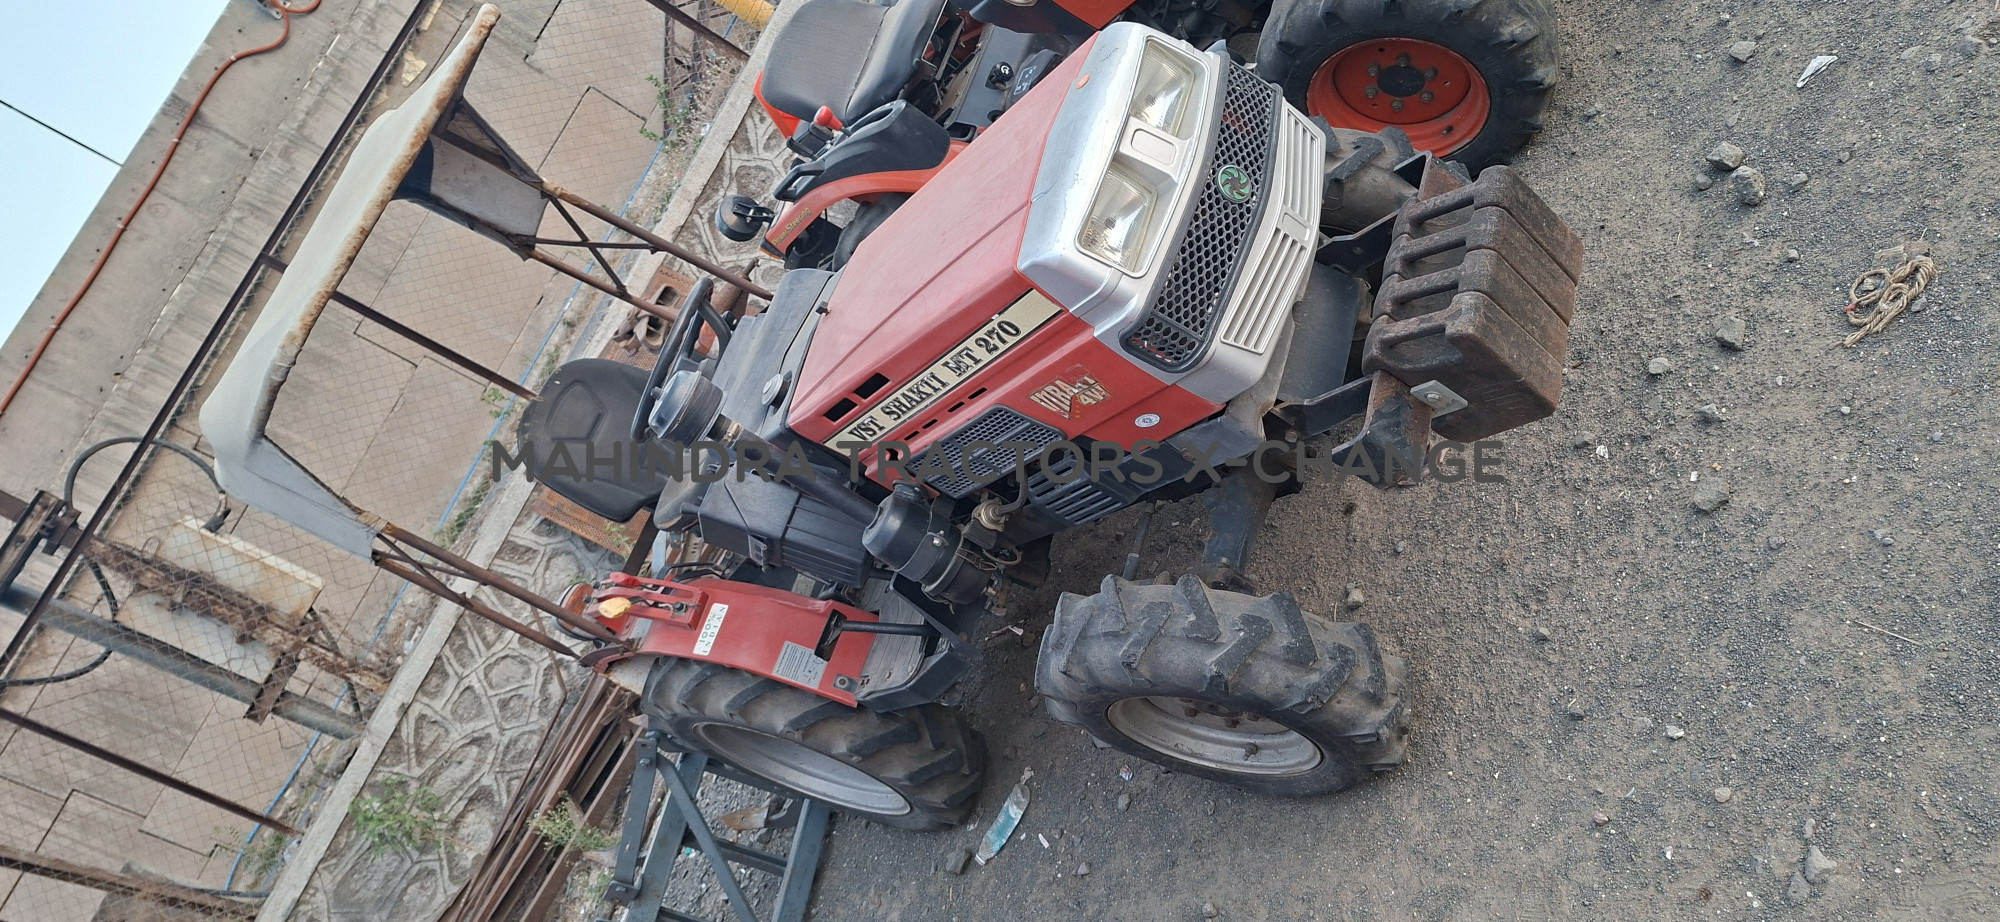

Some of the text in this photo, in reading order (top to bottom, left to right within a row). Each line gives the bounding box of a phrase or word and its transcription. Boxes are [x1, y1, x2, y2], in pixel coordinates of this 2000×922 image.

[847, 319, 1022, 441] VST SHAKTI MT 270
[699, 613, 716, 643] 100%
